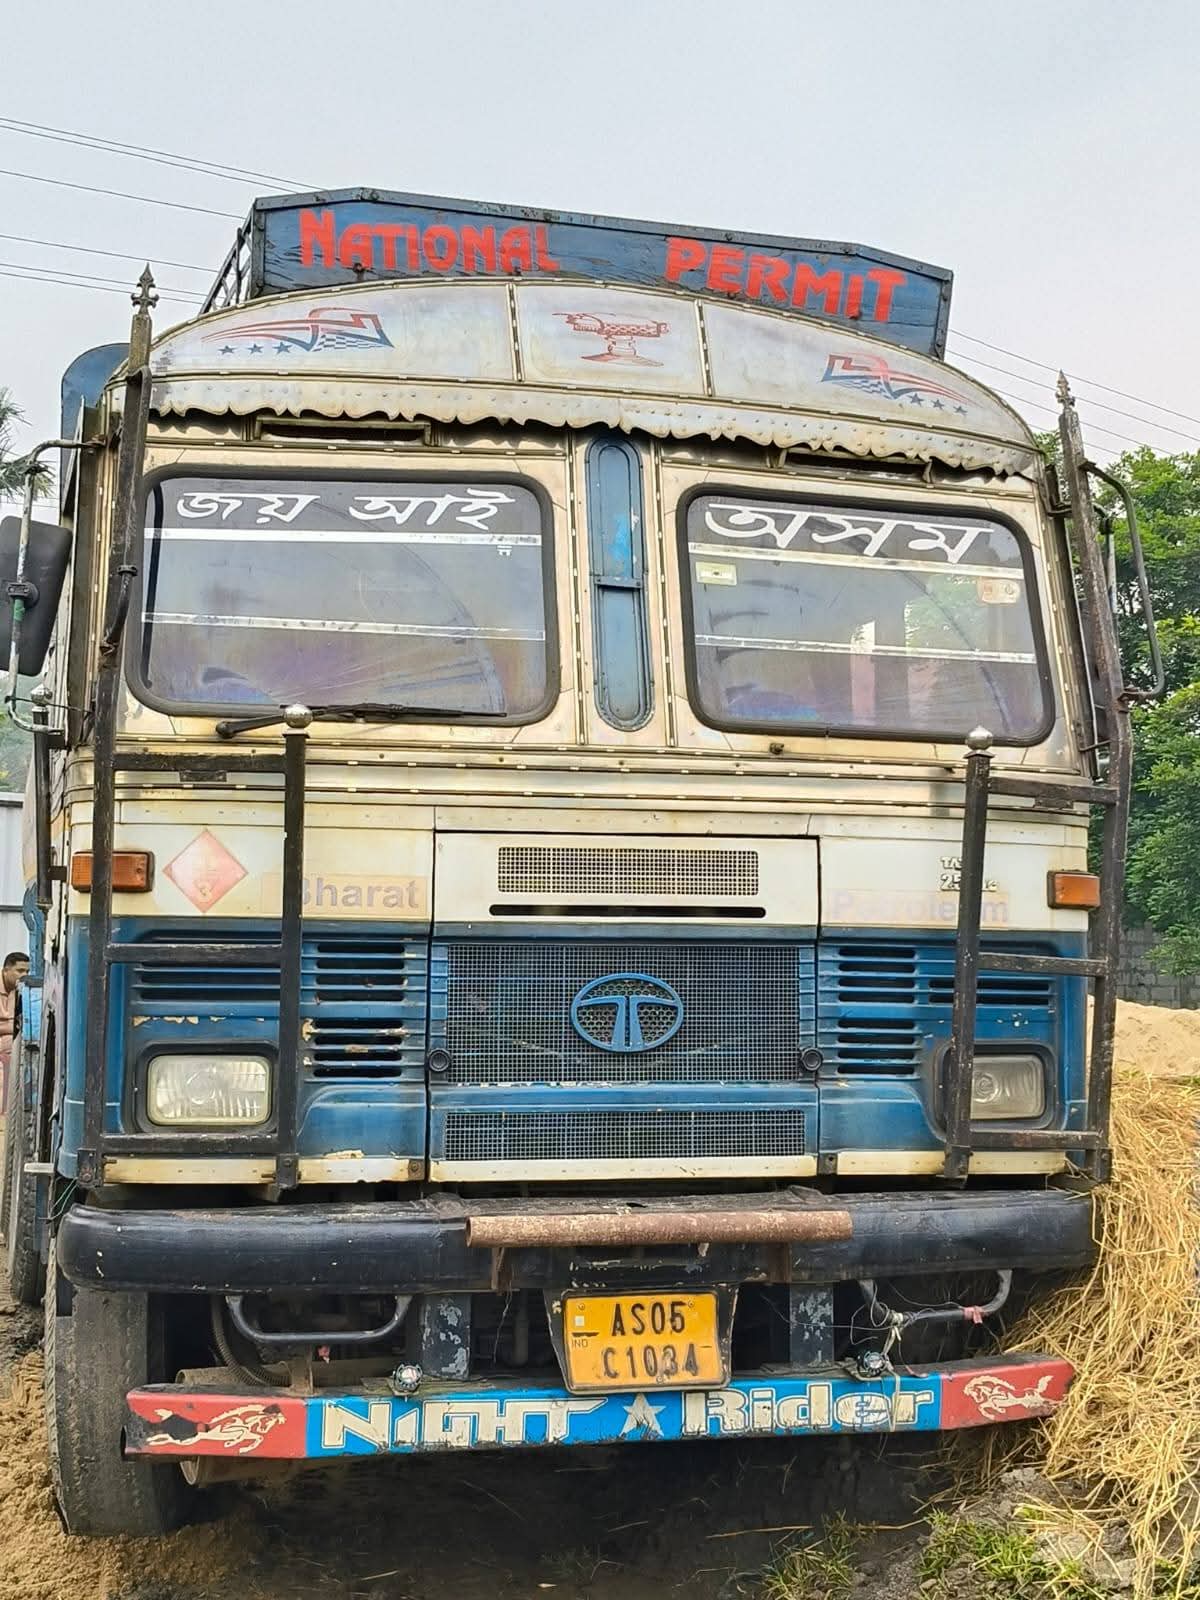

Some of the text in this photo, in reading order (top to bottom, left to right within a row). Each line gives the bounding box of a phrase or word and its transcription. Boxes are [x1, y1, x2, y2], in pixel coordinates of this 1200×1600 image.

[300, 208, 907, 323] NATIONAL PERMIT
[176, 487, 517, 531] জয় আই
[704, 503, 995, 564] অসম
[611, 1301, 688, 1337] AS05
[571, 1339, 589, 1349] IND
[682, 1382, 934, 1436] Rider
